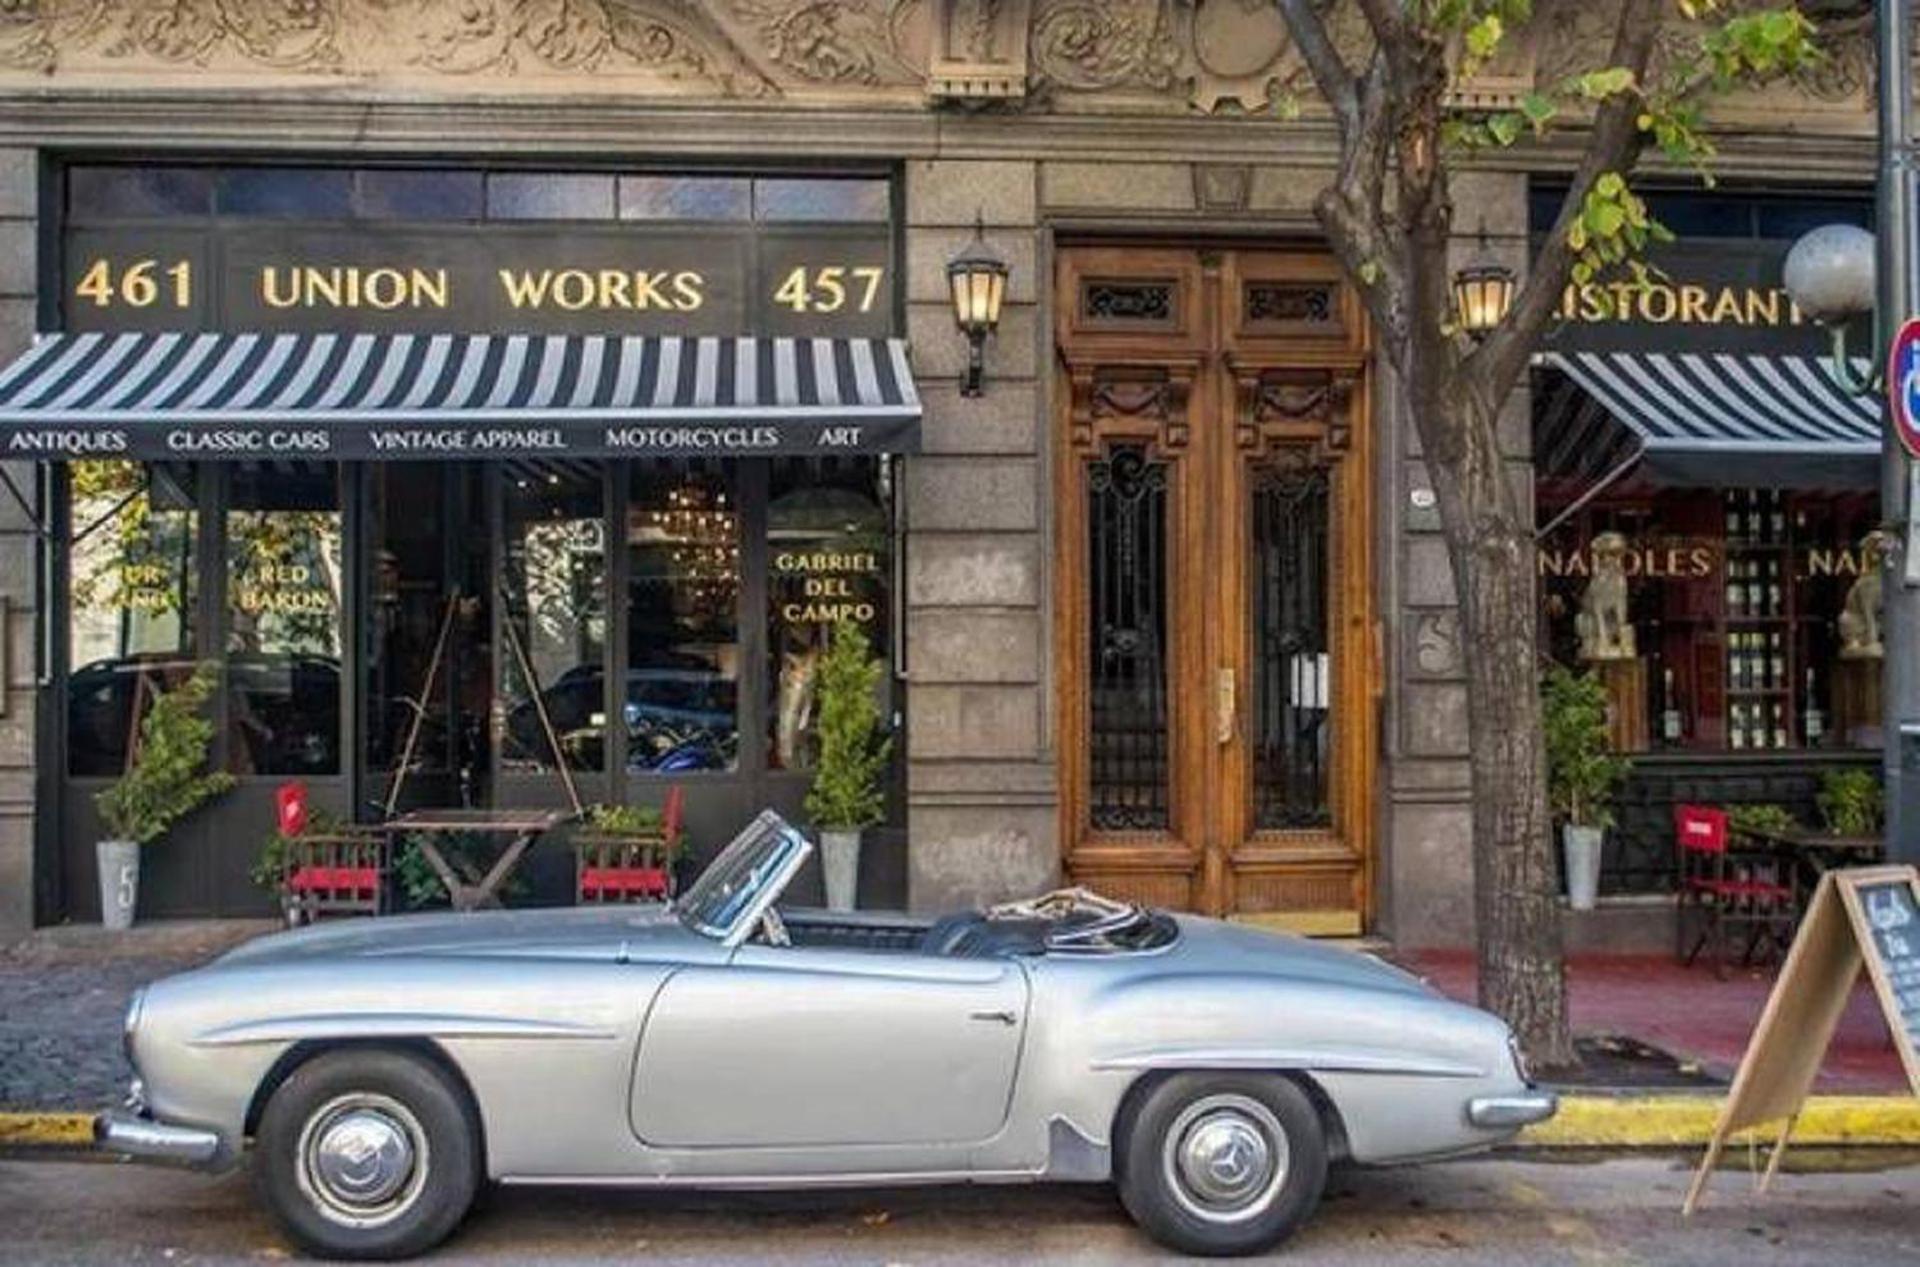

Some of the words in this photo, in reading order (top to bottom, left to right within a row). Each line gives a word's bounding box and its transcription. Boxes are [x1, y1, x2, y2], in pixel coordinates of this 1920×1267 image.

[76, 259, 192, 308] 461
[262, 266, 448, 308] UNION
[499, 268, 704, 312] WORKS
[774, 266, 884, 314] 457
[1552, 282, 1824, 325] ISTORANT
[9, 430, 128, 453] ANTIQUES
[167, 430, 263, 450] CLASSIC
[269, 430, 330, 451] CARS
[369, 430, 467, 450] VINTAGE
[471, 430, 568, 449] APPAREL
[606, 427, 779, 448] MOTORCYCLES
[818, 427, 864, 447] ART
[775, 553, 879, 572] GABRIEL
[260, 565, 310, 583] RED
[804, 578, 852, 597] DEL
[240, 591, 330, 611] BARON
[783, 603, 876, 623] CAMPO
